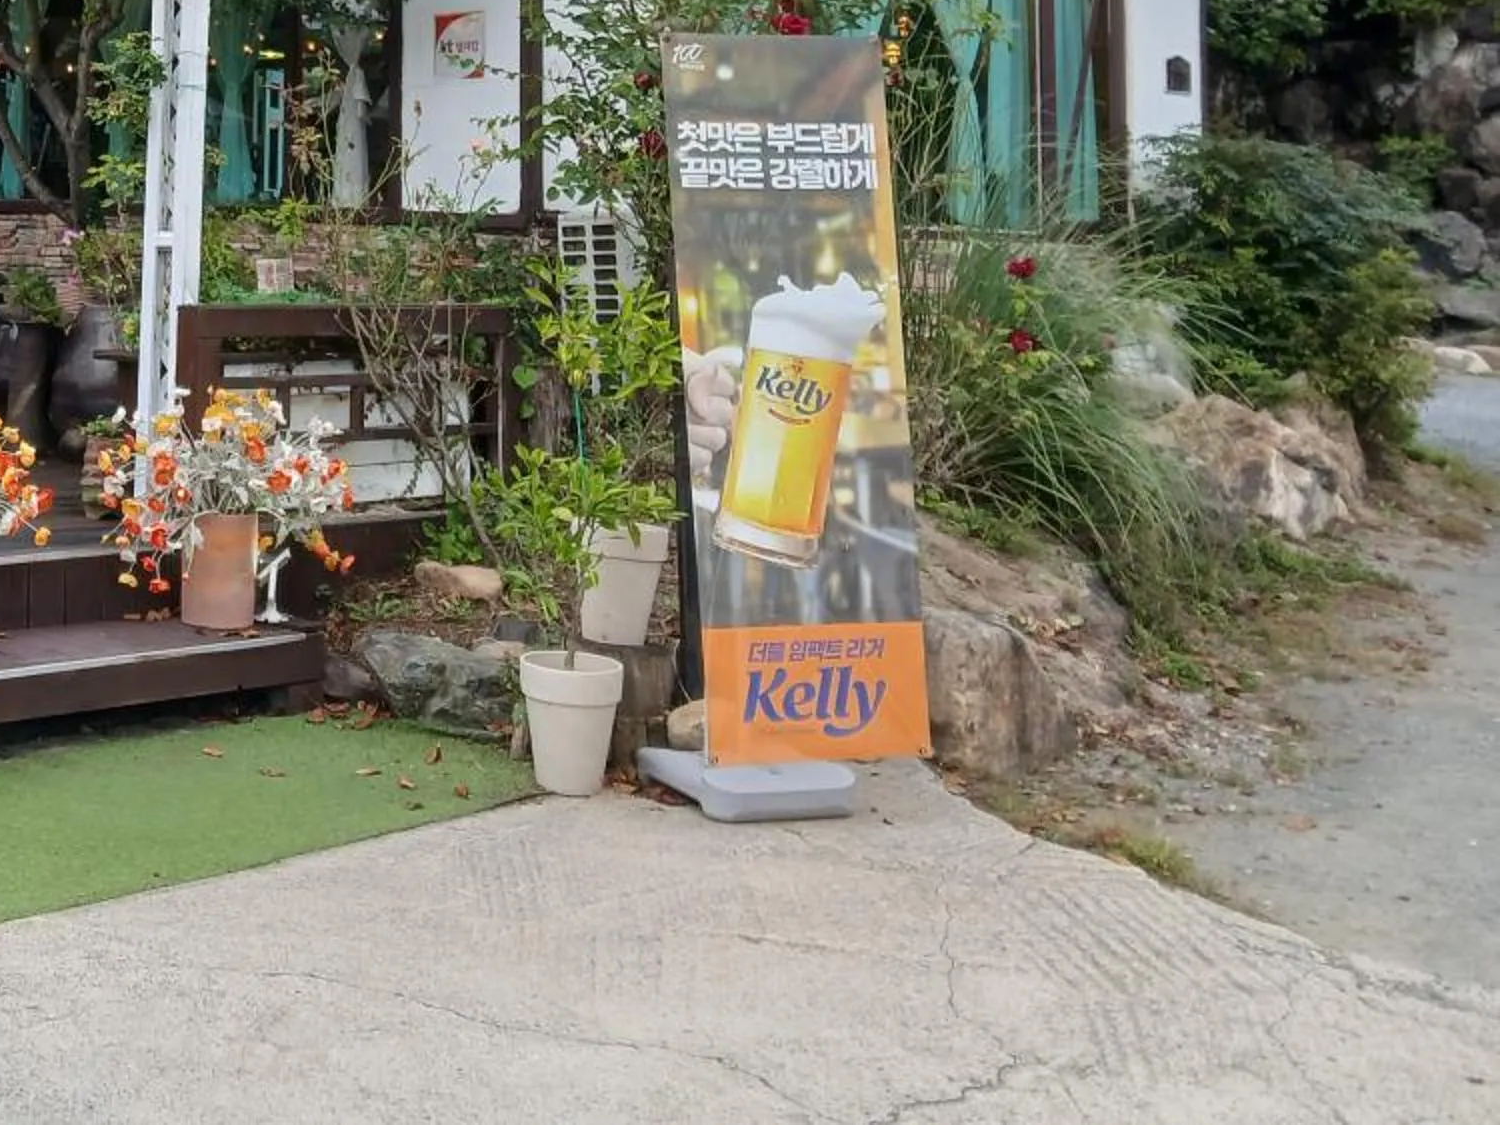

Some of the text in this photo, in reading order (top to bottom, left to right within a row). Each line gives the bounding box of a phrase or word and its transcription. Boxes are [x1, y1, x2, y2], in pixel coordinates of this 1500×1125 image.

[677, 121, 876, 154] 첫맛은 부드럽게
[680, 157, 878, 190] 끝맛은 강렬하게
[755, 365, 833, 415] Kelly
[748, 637, 885, 663] 더블 임팩트 라거
[743, 665, 887, 737] Kelly
